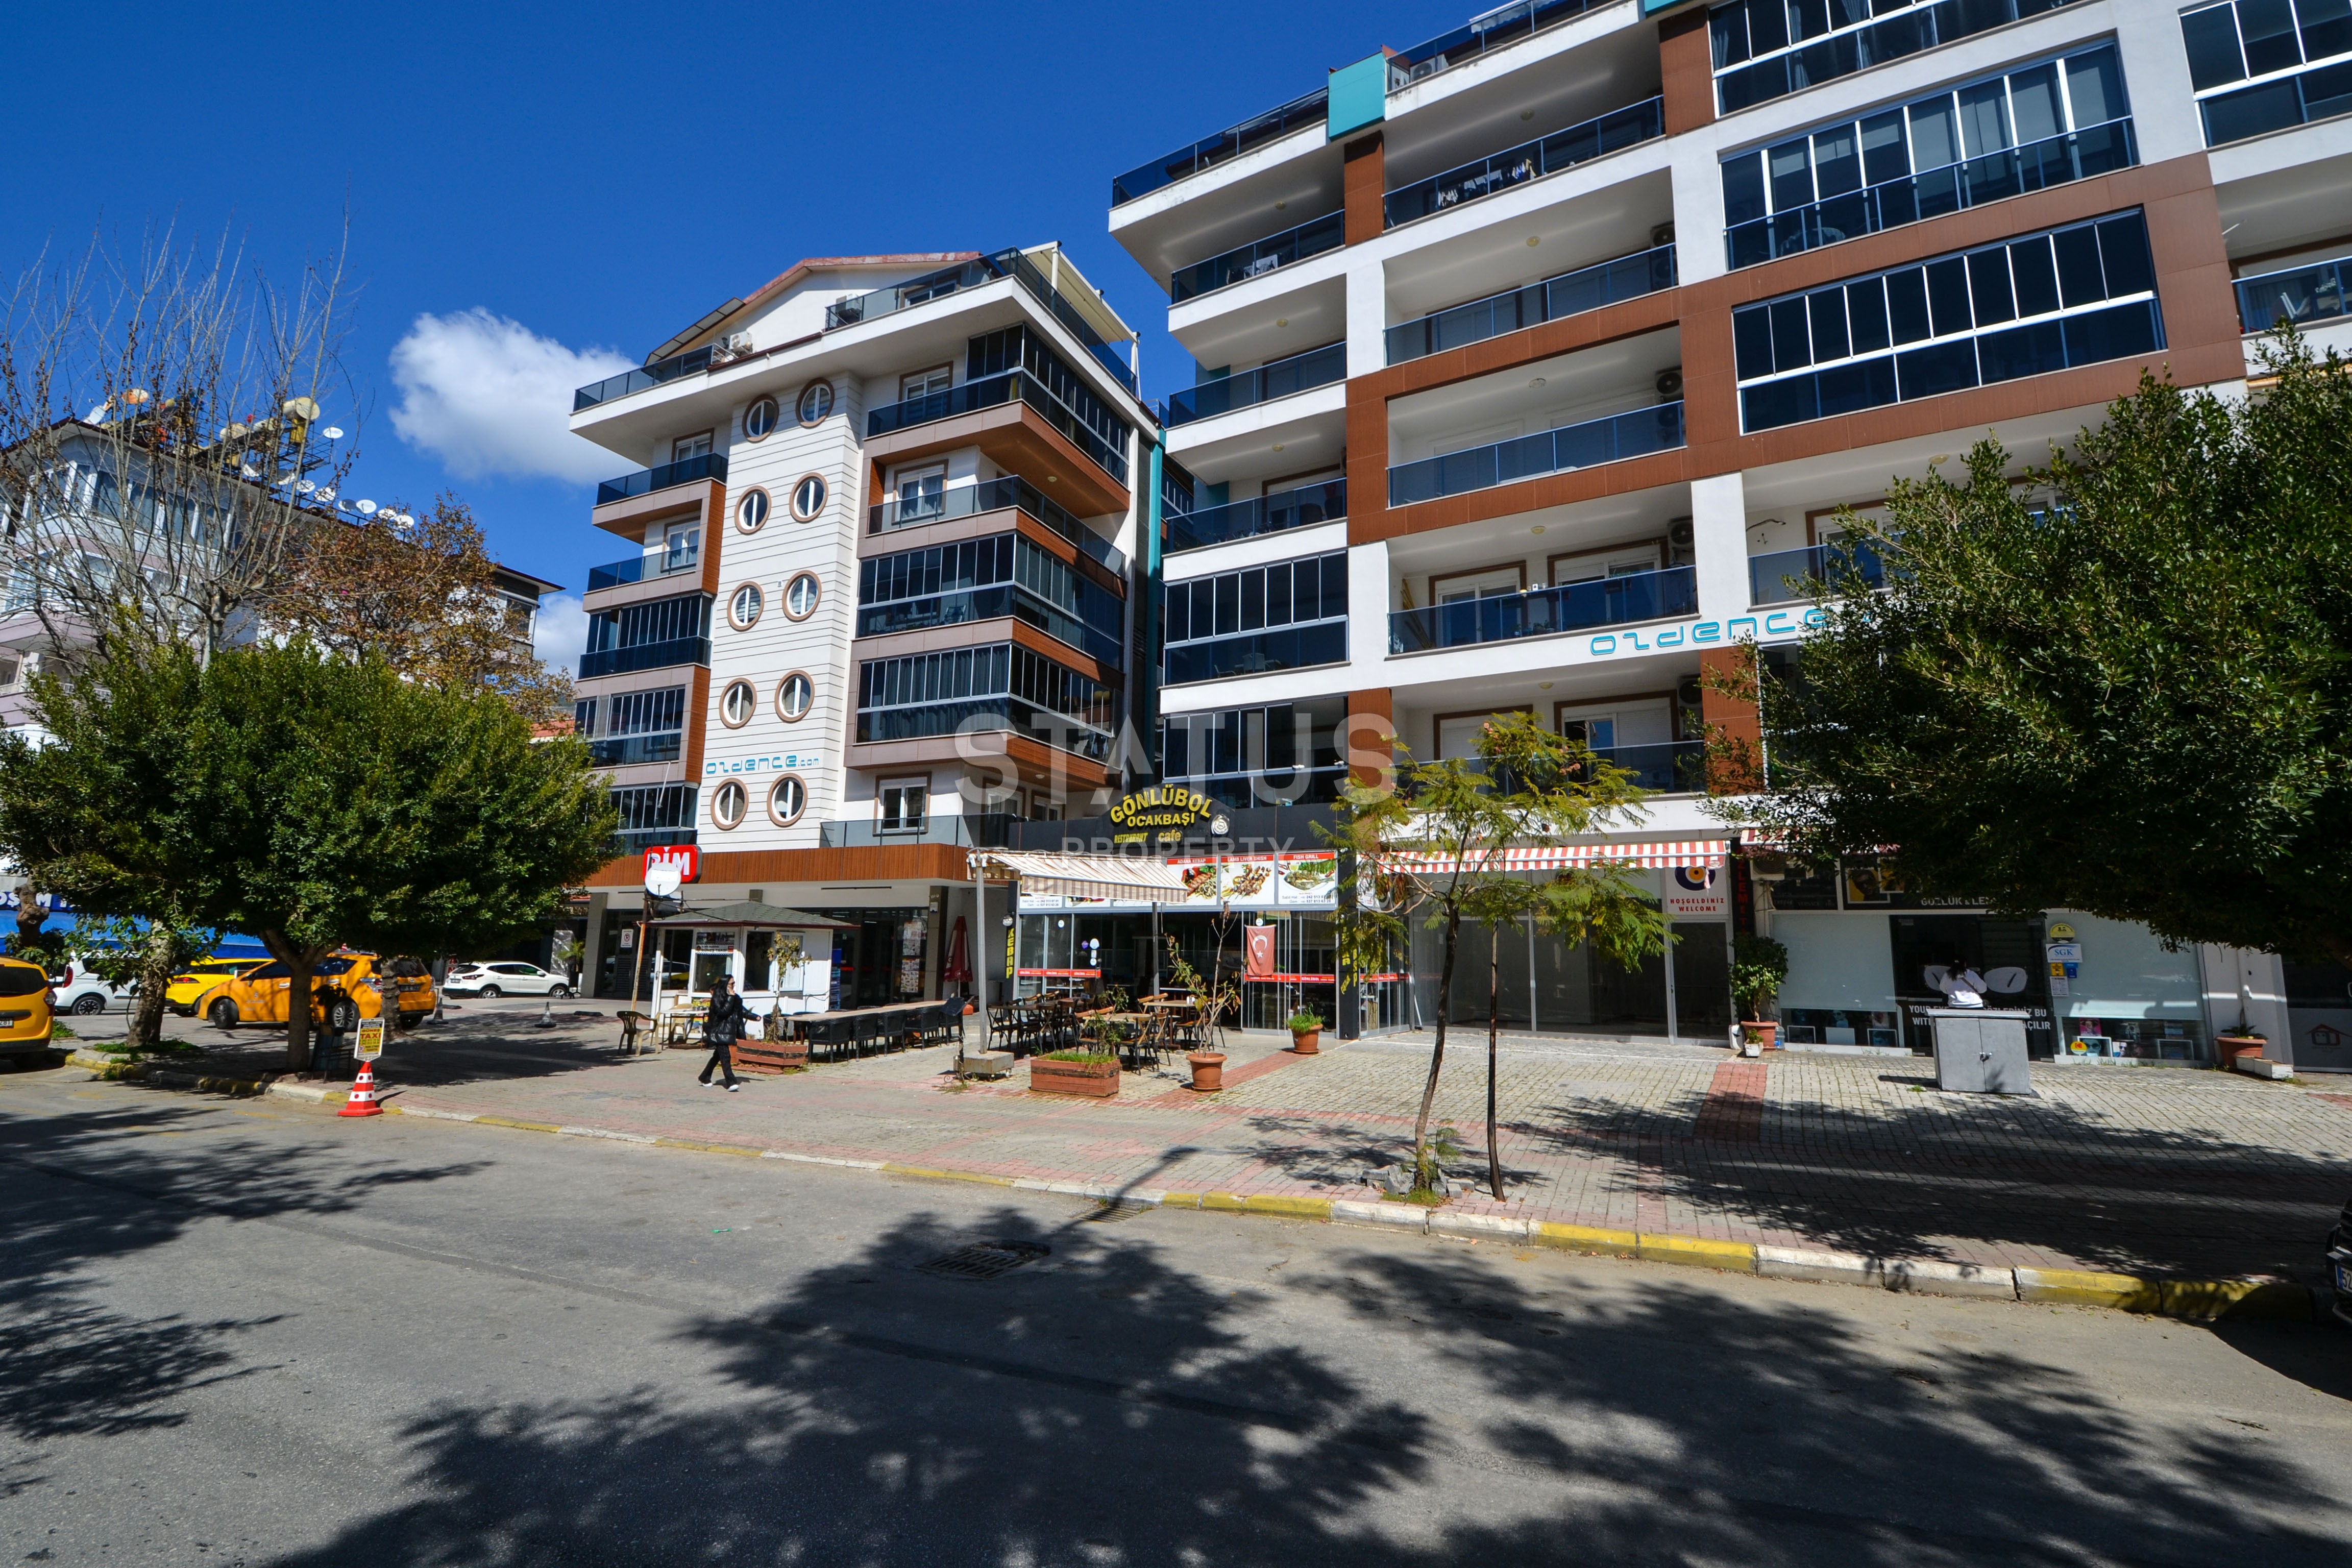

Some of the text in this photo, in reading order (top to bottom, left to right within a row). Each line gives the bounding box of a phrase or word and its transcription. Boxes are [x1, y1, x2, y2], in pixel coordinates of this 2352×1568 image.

[1111, 784, 1212, 823] GÖNLÜBOL
[1127, 813, 1195, 827] OCAKBAŞI
[1158, 829, 1182, 842] cafe
[1670, 897, 1725, 905] HOŞGELDİNİZ
[1006, 928, 1014, 979] KEBAP
[2035, 1009, 2047, 1017] BU
[2022, 1021, 2051, 1030] AÇILIR
